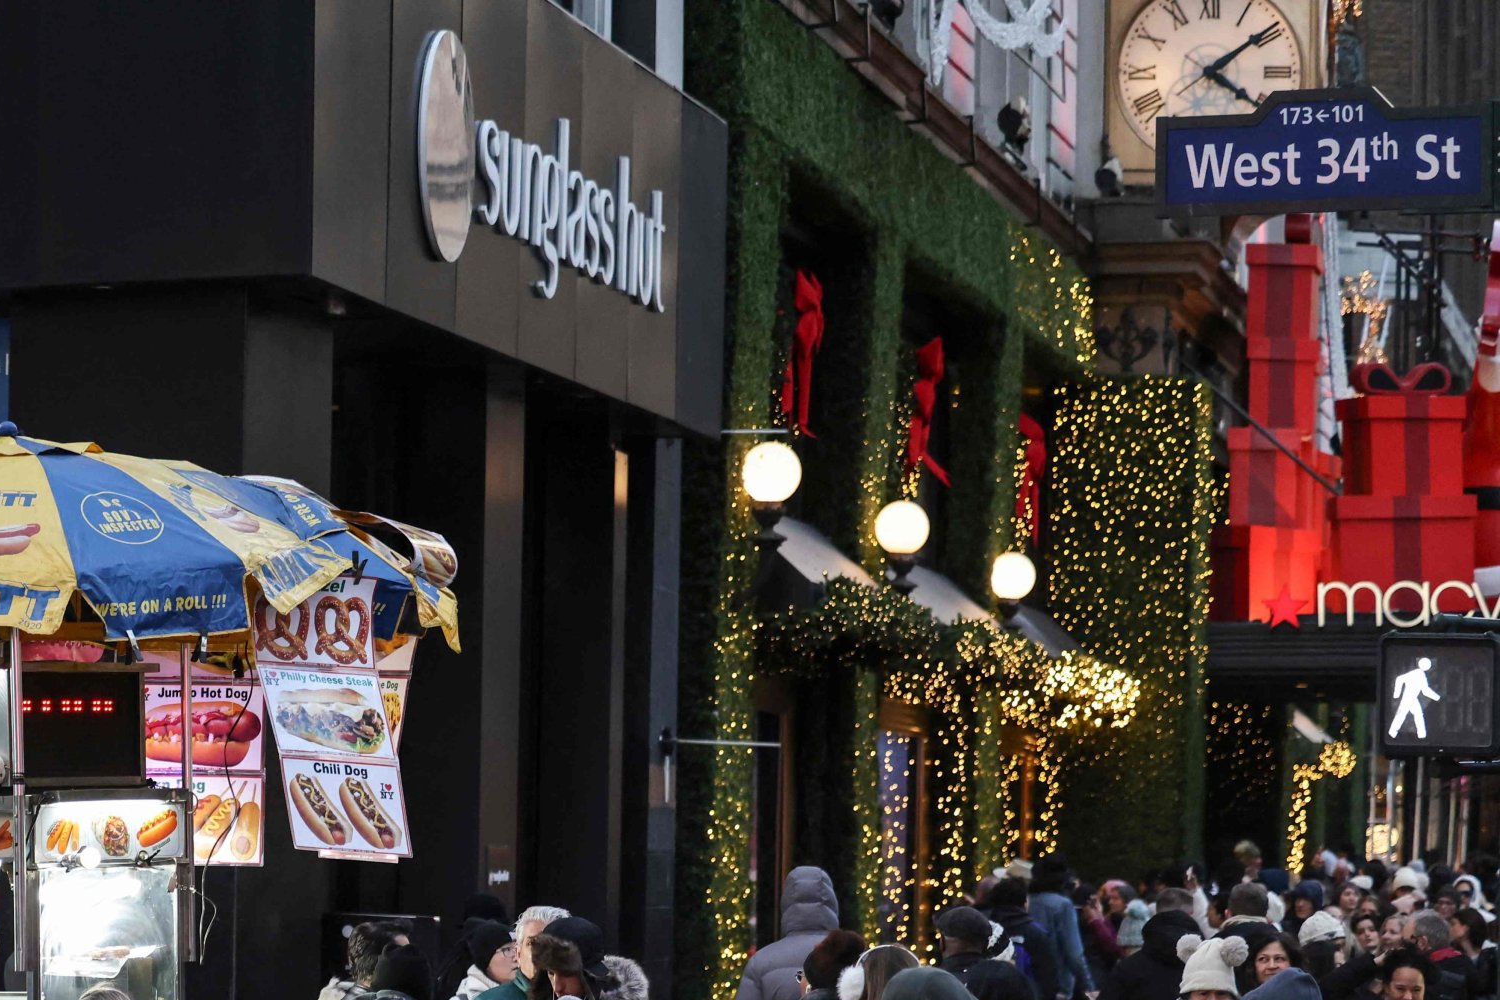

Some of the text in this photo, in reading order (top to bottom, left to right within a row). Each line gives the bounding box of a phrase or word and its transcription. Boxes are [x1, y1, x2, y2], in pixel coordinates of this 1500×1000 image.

[1279, 104, 1364, 126] 173 101
[1184, 142, 1302, 190] West
[1316, 131, 1399, 184] 34th
[1415, 133, 1461, 180] St
[476, 117, 666, 314] sunglass hut
[98, 518, 161, 534] INSPECTED
[95, 601, 137, 618] WE'RE
[140, 599, 160, 614] ON
[163, 598, 172, 612] A
[175, 595, 208, 612] ROLL
[280, 671, 374, 687] Philly Cheese Steak
[386, 680, 399, 691] Dog
[157, 687, 248, 701] Jumo Hot Dog
[313, 761, 369, 779] Chili Dog
